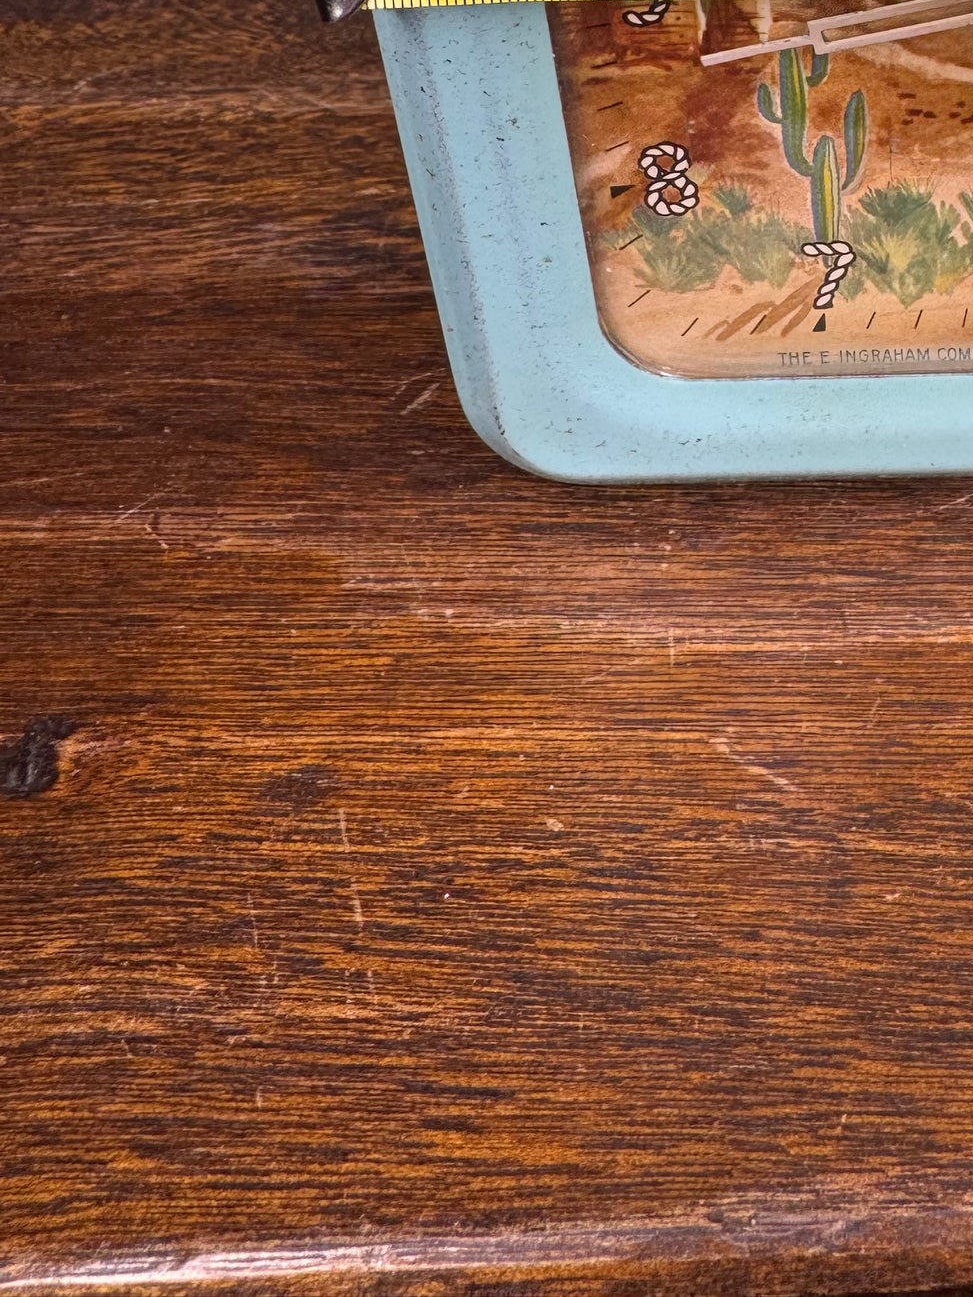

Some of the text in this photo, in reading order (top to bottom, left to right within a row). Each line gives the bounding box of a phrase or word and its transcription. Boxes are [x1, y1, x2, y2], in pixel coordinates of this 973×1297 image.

[638, 141, 699, 216] 8
[801, 240, 855, 309] 7
[777, 350, 811, 367] THE
[839, 348, 931, 364] INGRAHAM
